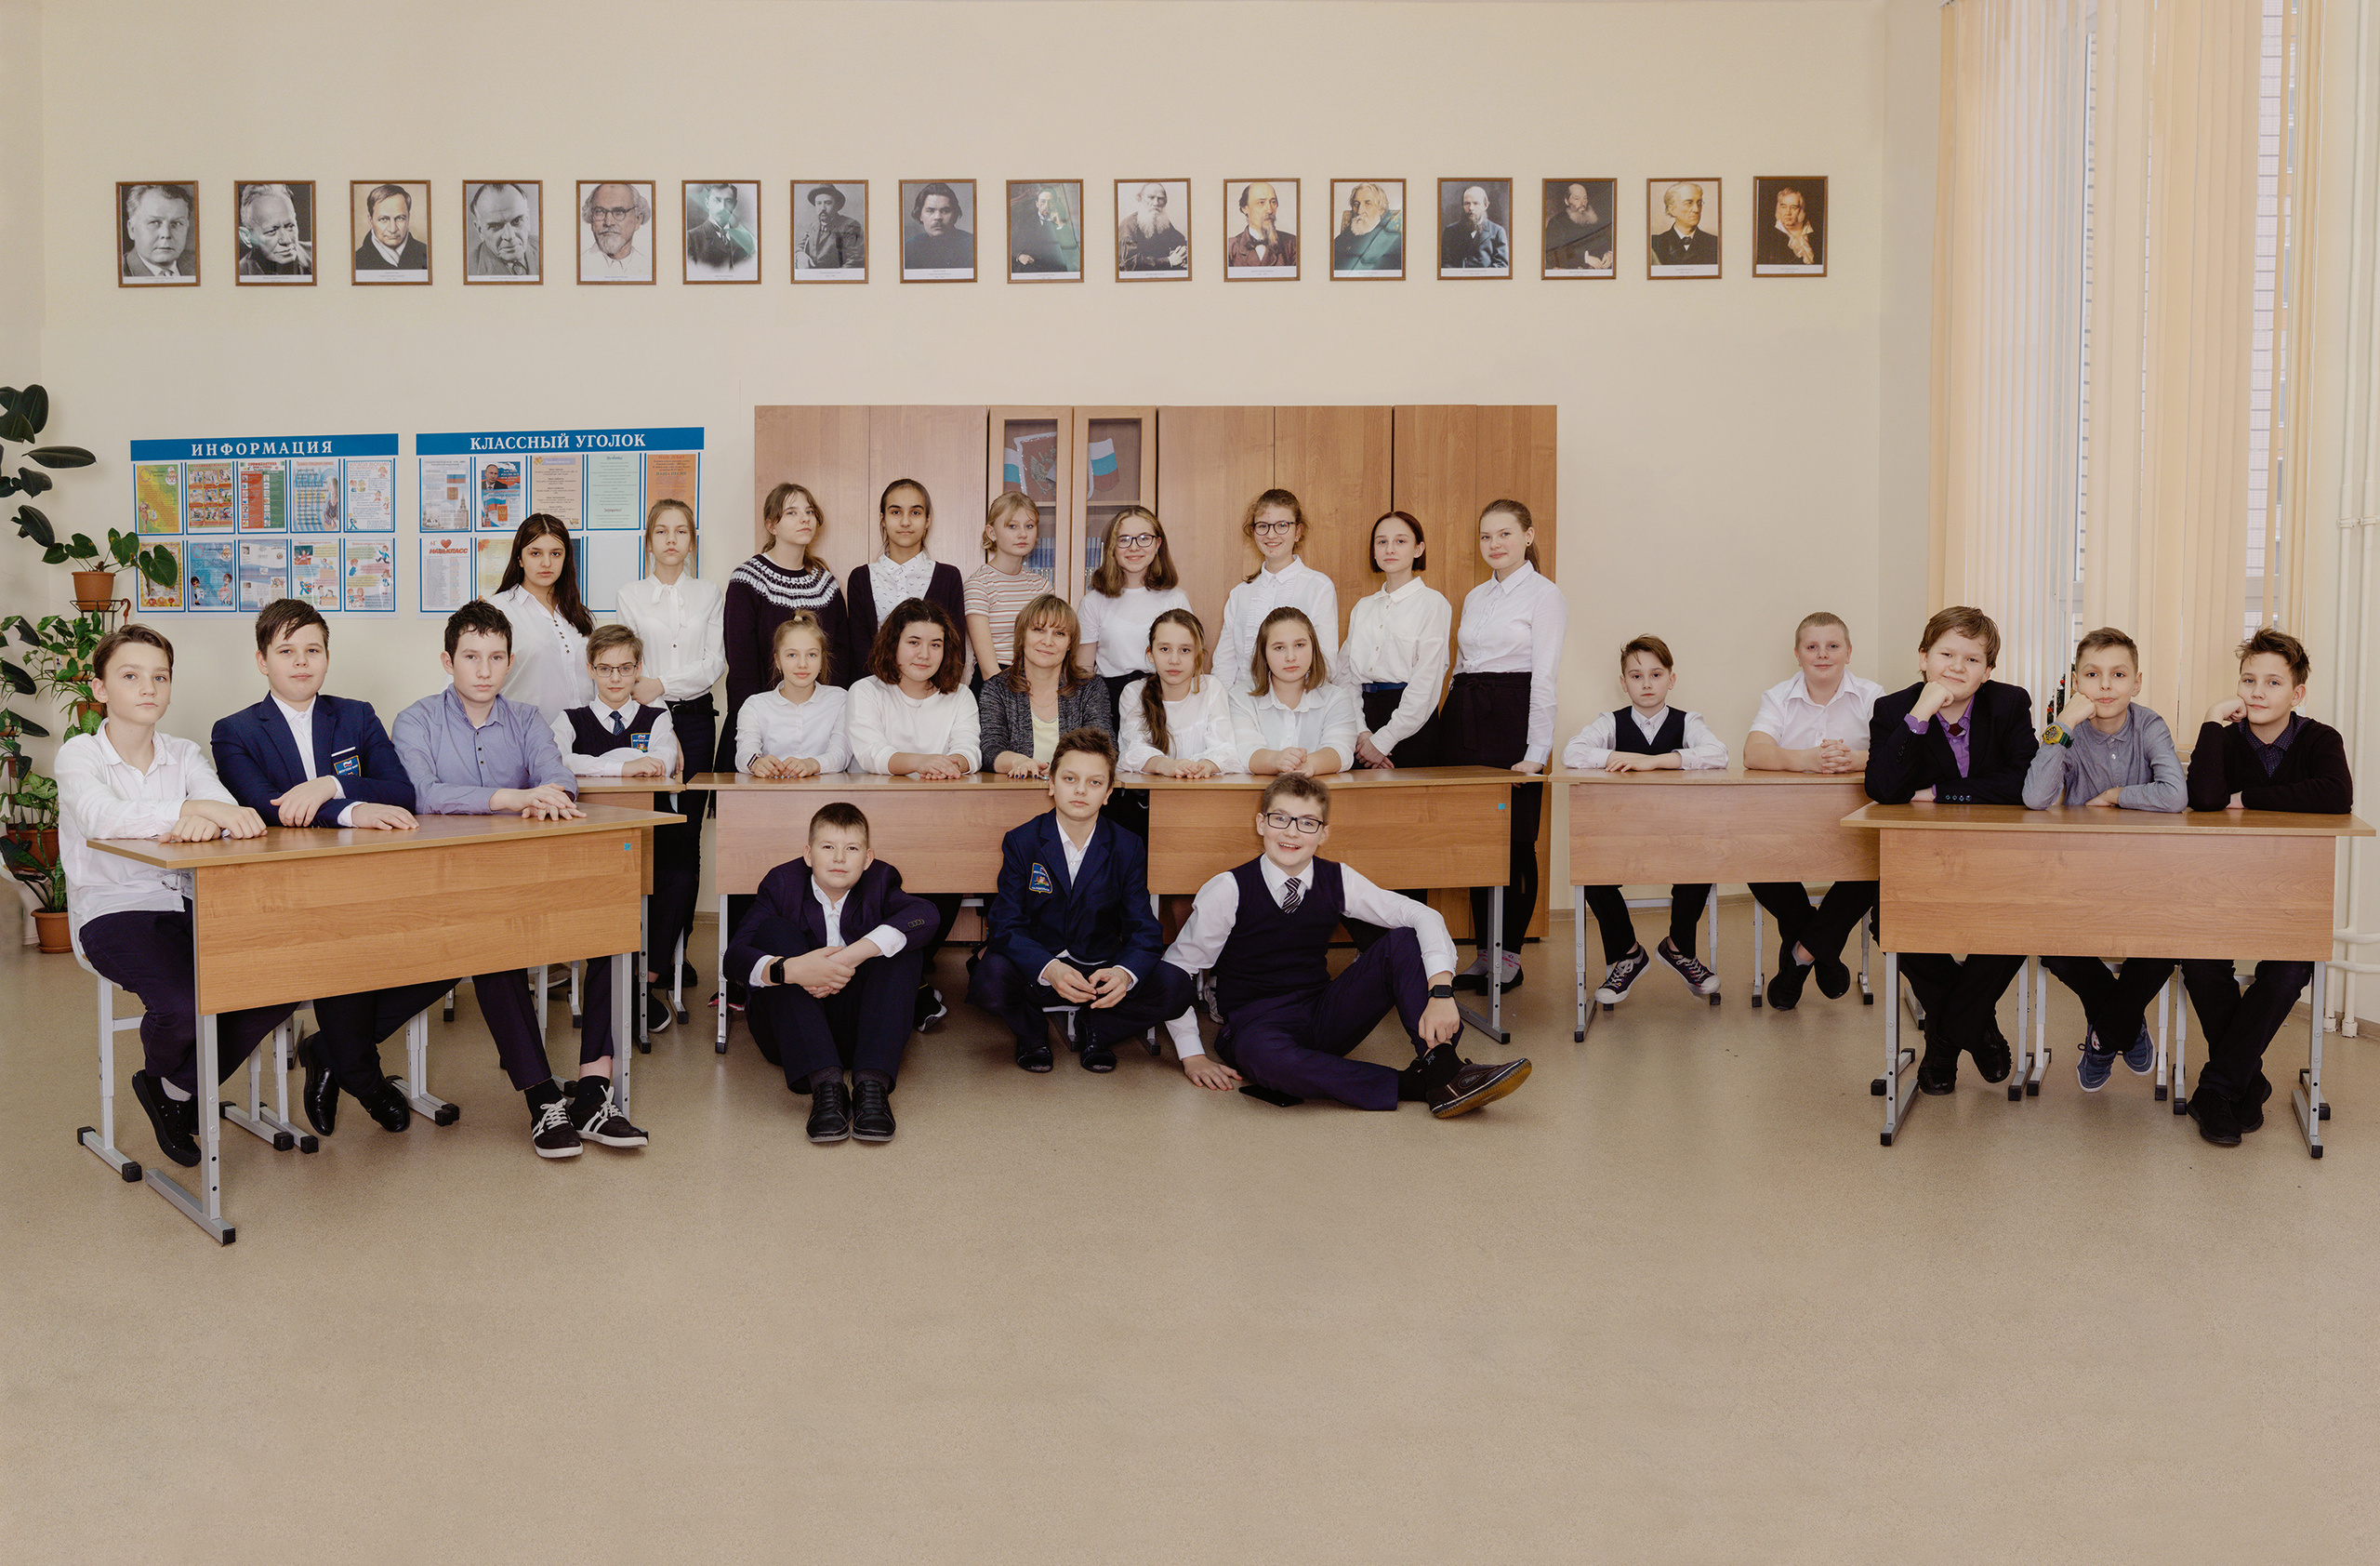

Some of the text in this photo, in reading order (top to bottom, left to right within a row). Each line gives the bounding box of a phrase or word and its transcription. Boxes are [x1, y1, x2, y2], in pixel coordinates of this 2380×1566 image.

[191, 441, 333, 457] ИНФОРМАЦИЯ
[469, 433, 646, 450] КЛАССНЫЙ УГОЛОК
